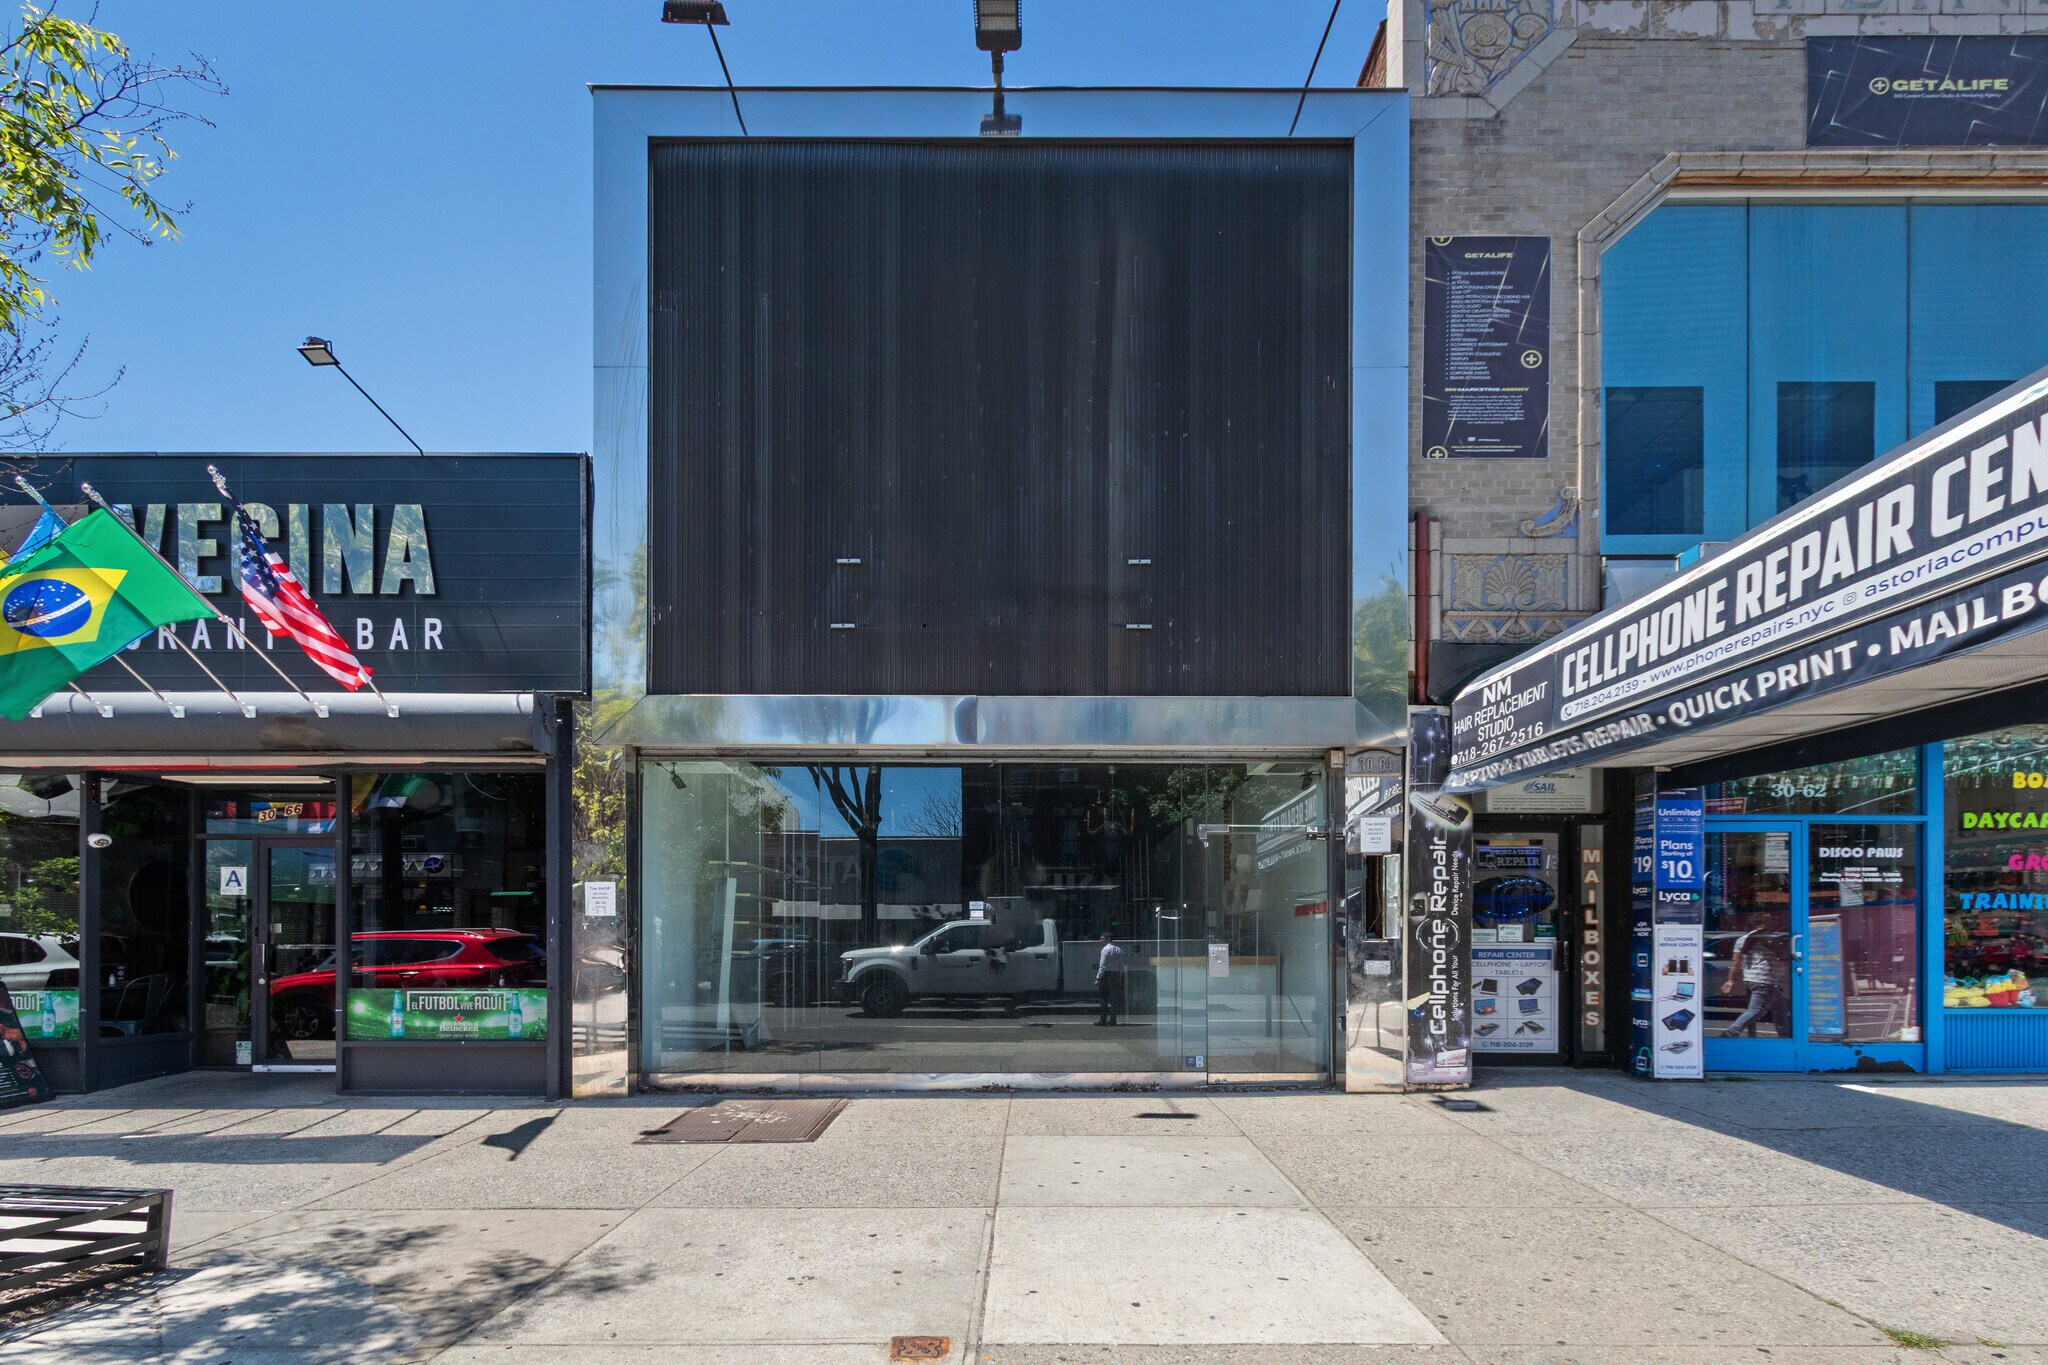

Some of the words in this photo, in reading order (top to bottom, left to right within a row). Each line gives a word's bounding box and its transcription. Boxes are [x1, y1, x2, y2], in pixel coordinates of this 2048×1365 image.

[1892, 78, 2009, 91] GETALIFE
[1562, 577, 1728, 698] CELLPHONE
[1735, 484, 1915, 625] REPAIR
[357, 617, 444, 650] BAR
[1574, 678, 1640, 714] 718.204.2139
[1650, 599, 1835, 683] www.phonerepairs.nyc
[1483, 675, 1512, 707] NM
[1584, 713, 1658, 751] REPAIR
[1668, 678, 1750, 728] QUICK
[1756, 640, 1859, 698] PRINT
[1453, 714, 1473, 736] HAIR
[1474, 681, 1548, 728] REPLACEMENT
[1477, 715, 1514, 742] STUDIO
[1457, 722, 1544, 766] 718-267-2516
[1358, 758, 1373, 772] 30
[1379, 758, 1393, 772] 64
[1533, 782, 1557, 791] SAIL
[1769, 783, 1827, 798] 30-62
[260, 809, 275, 821] 30
[285, 804, 302, 815] 66
[1658, 808, 1702, 817] Unlimited
[1660, 840, 1694, 850] Plans
[1819, 847, 1864, 858] DISCO
[1866, 847, 1904, 858] PAWS
[1496, 857, 1541, 866] REPAIR
[1660, 850, 1685, 858] Starting
[1634, 856, 1652, 873] $19
[1662, 860, 1693, 879] $10
[225, 870, 242, 887] A
[1429, 837, 1450, 913] Repair
[1632, 886, 1648, 895] Lyca
[1659, 891, 1691, 903] Lyca
[1959, 893, 2048, 910] TRAINI
[1582, 848, 1601, 1026] MAILBOXES
[1478, 951, 1505, 959] REPAIR
[1505, 951, 1536, 959] CENTER
[1429, 919, 1450, 1035] Cellphone
[419, 996, 460, 1010] FUTBOL
[1451, 992, 1459, 1022] Solutions
[439, 1024, 479, 1032] Heineken
[1632, 1018, 1648, 1027] Lyca
